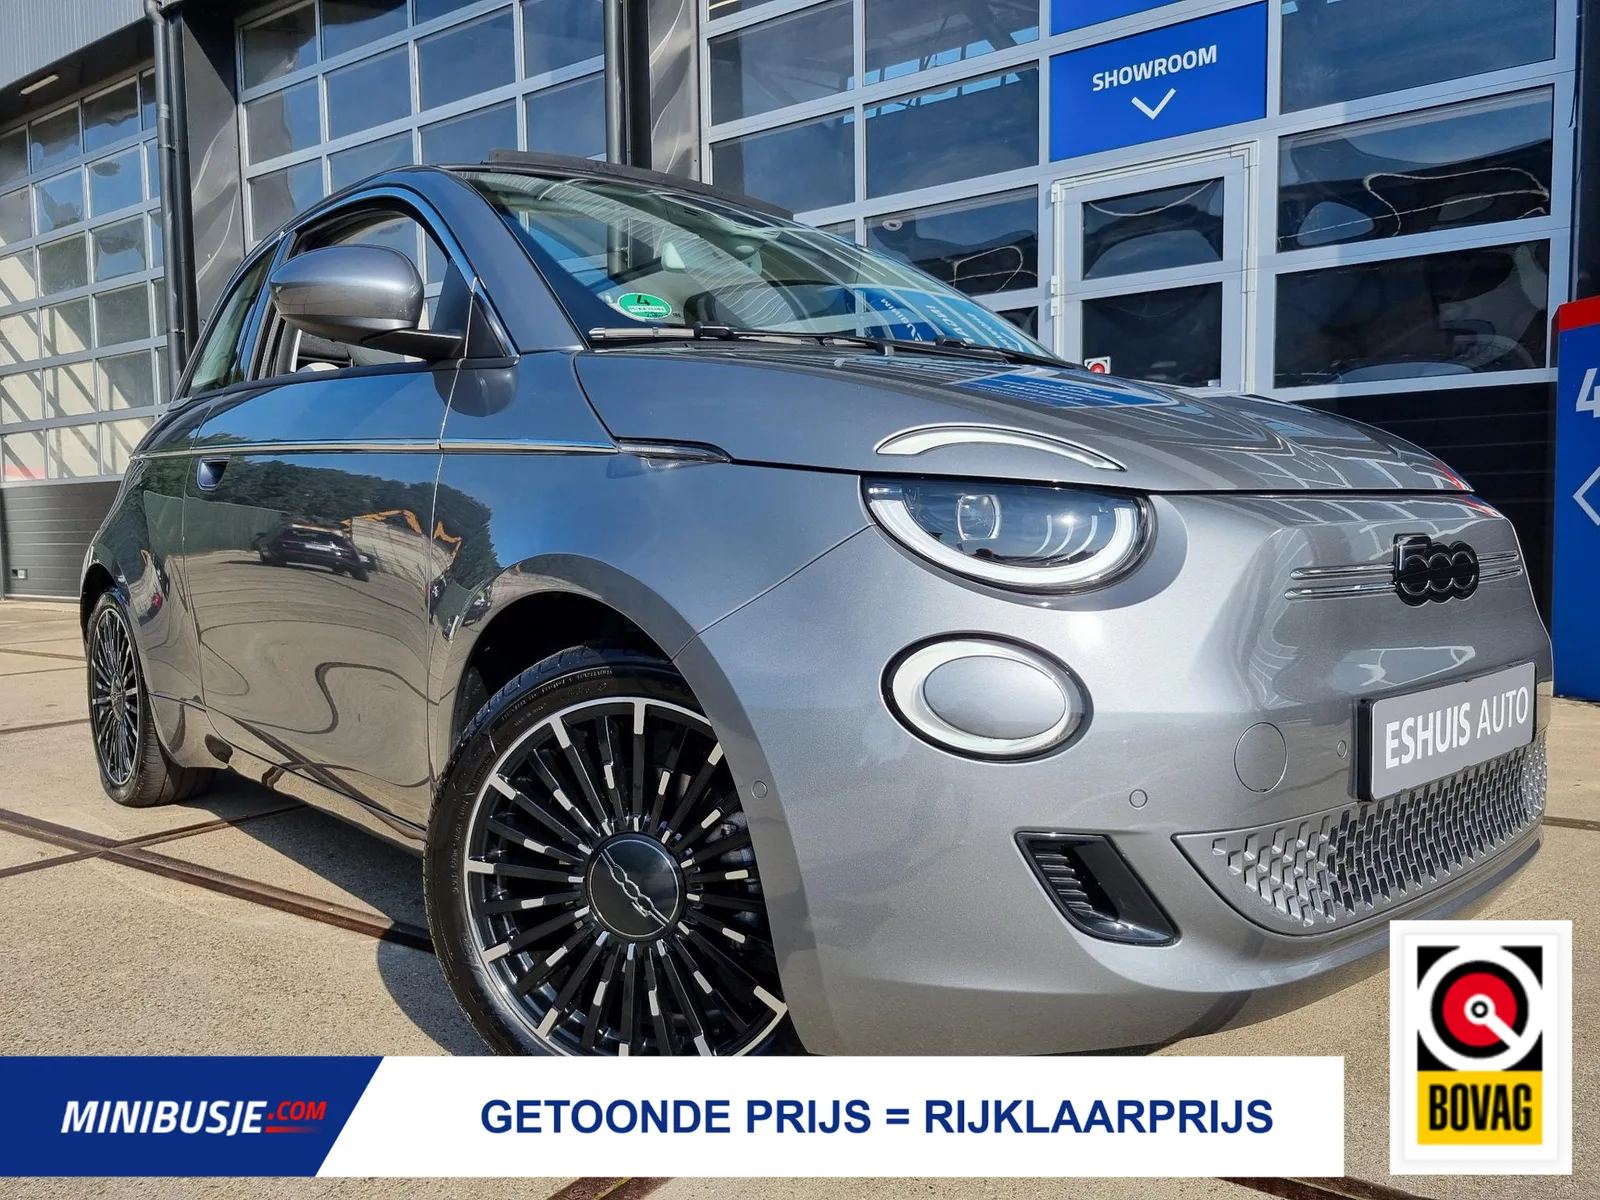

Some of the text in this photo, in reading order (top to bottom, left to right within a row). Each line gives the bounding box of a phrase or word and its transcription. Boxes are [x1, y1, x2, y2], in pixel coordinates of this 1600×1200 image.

[1092, 45, 1218, 92] SHOWROOM
[1385, 686, 1529, 769] ESHUIS AUTO
